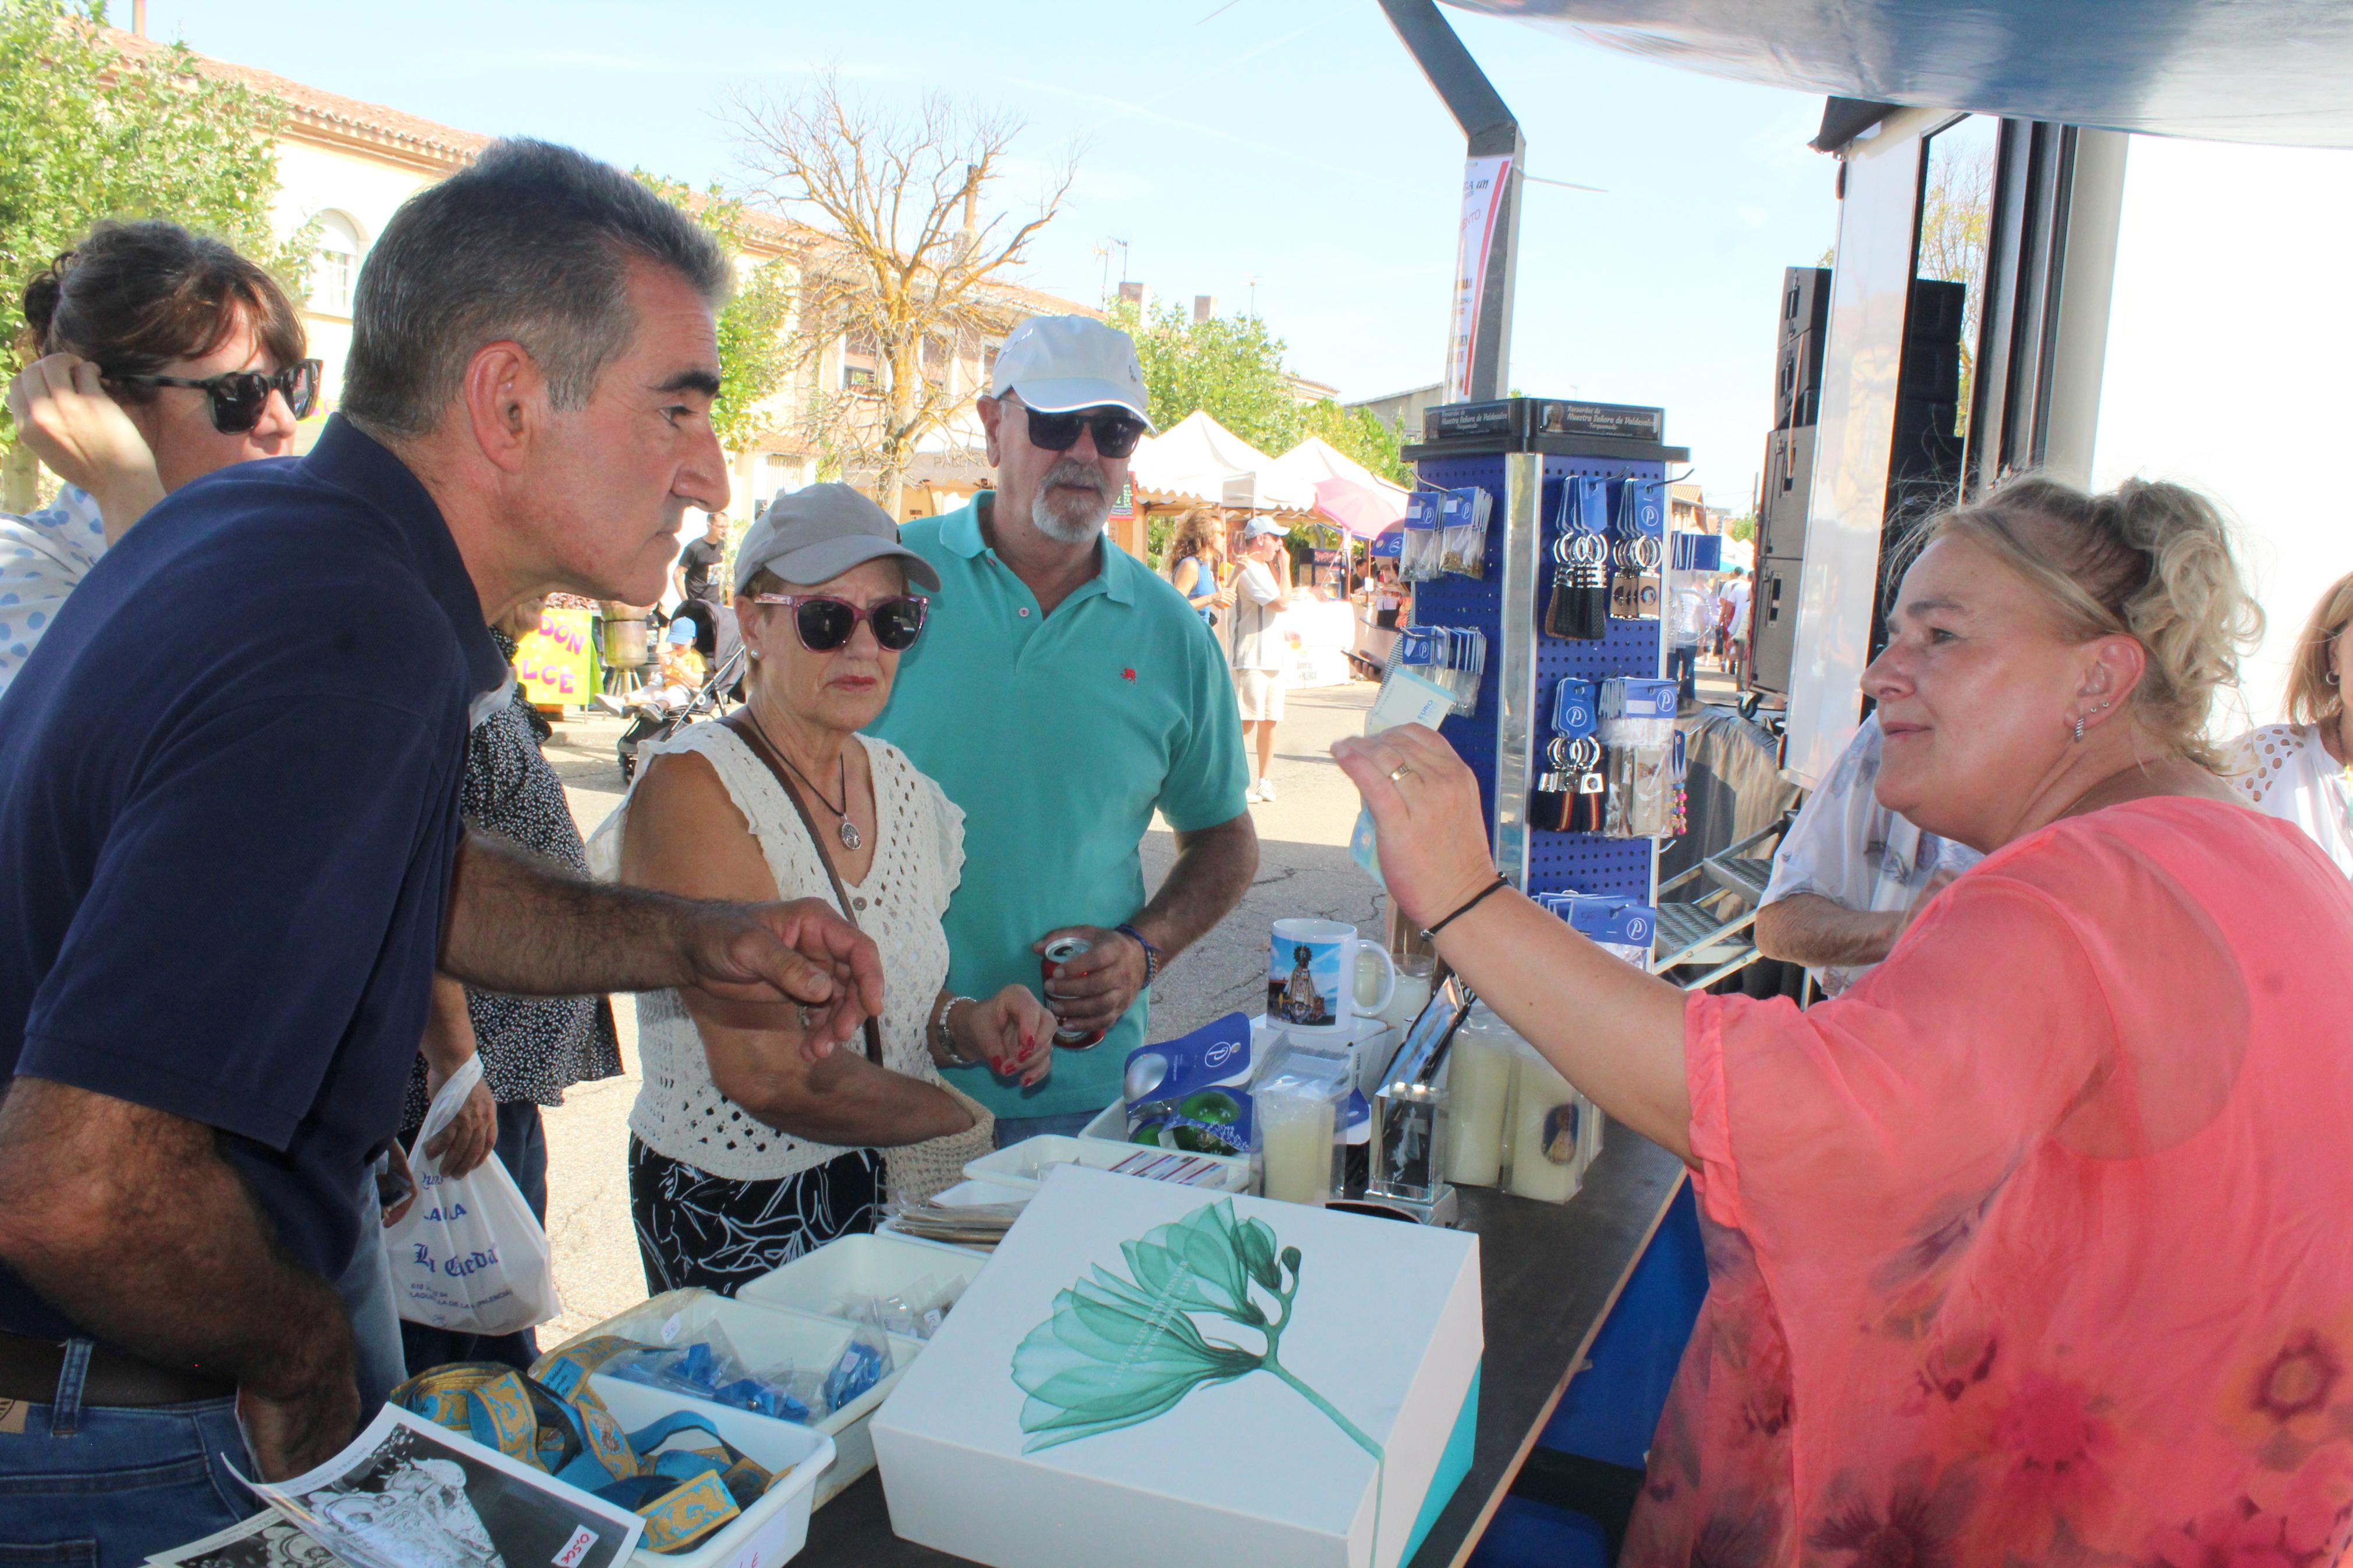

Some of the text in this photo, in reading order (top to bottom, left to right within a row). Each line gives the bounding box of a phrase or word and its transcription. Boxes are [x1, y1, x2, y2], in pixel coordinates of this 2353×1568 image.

[1567, 413, 1592, 421] Nuestra
[1593, 414, 1614, 424] Señora
[1616, 416, 1623, 425] de
[523, 659, 575, 694] LCE
[1417, 699, 1435, 720] EURO
